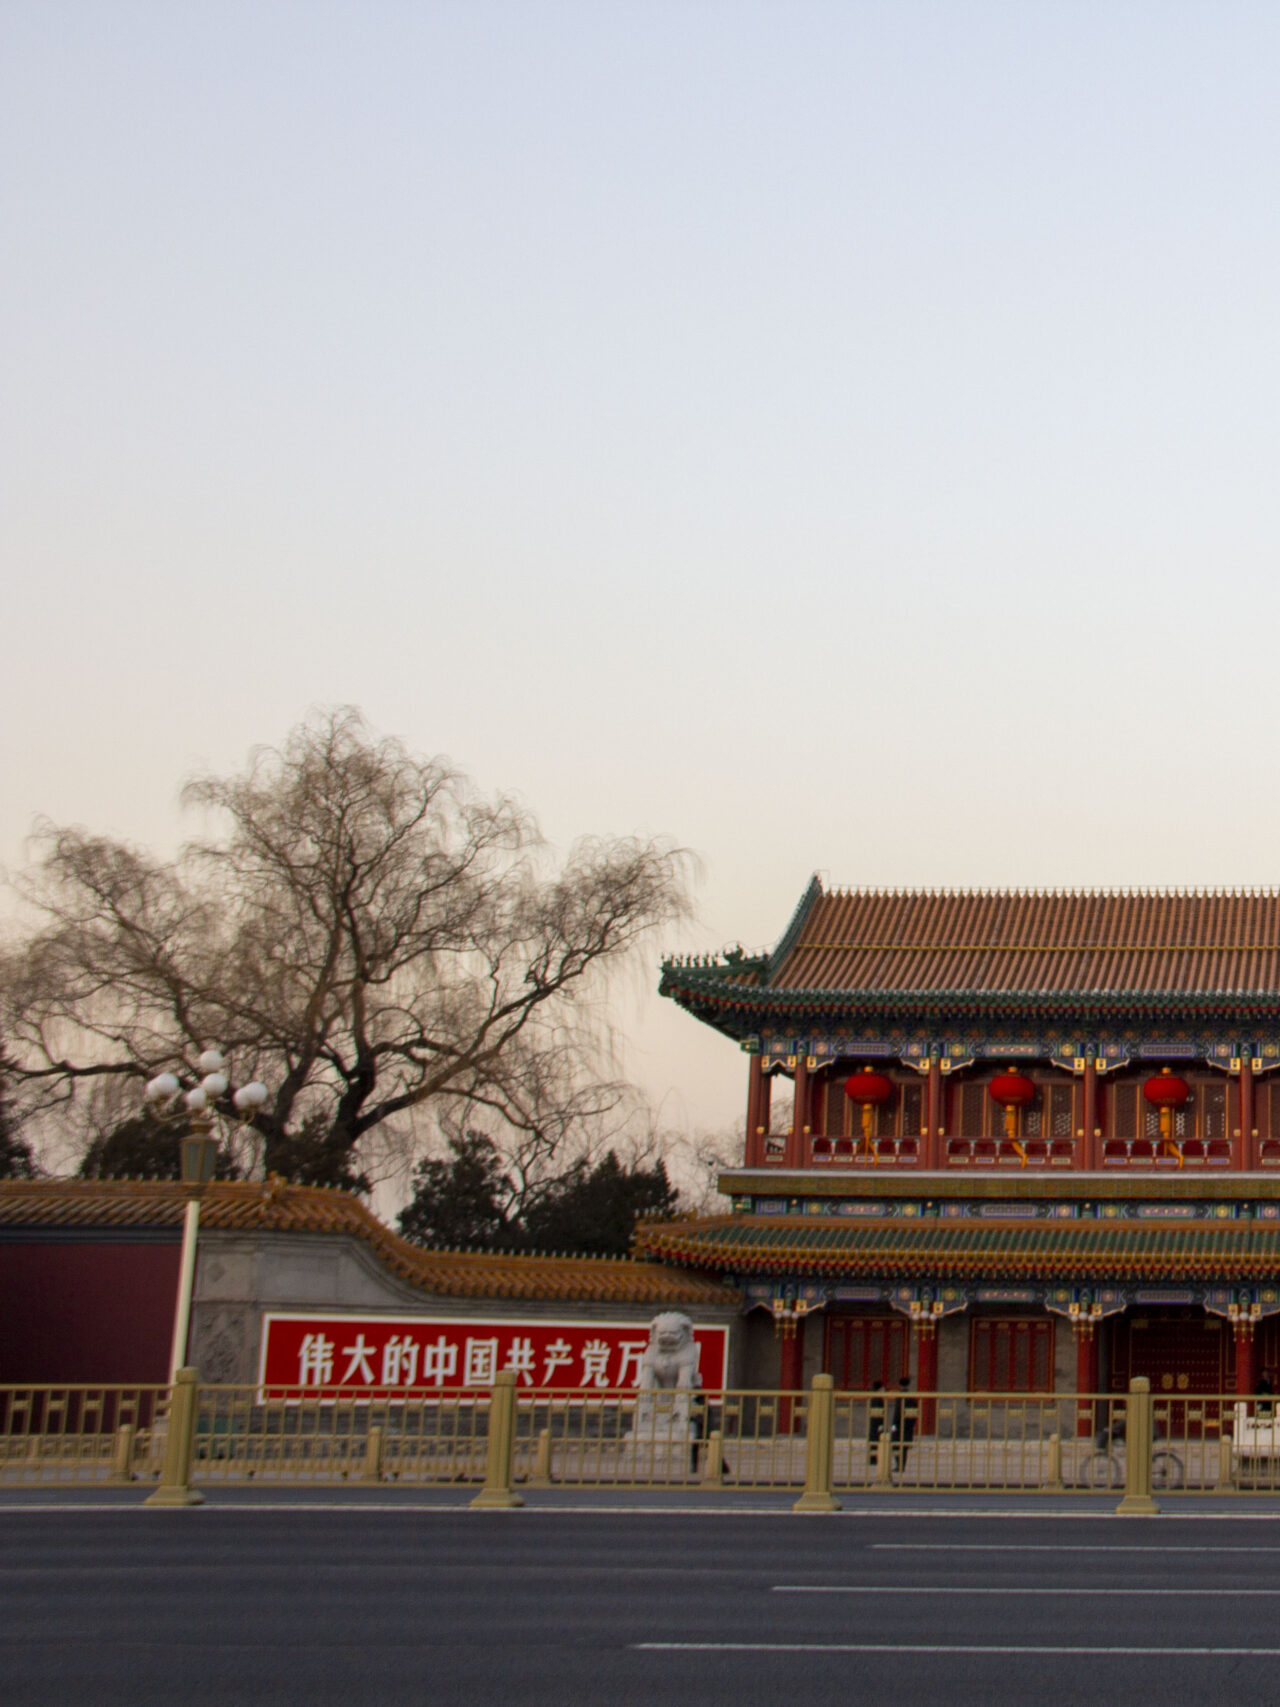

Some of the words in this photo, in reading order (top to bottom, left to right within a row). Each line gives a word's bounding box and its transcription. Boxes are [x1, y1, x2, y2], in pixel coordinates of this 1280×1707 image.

[298, 1333, 703, 1387] 伟大的中国共产党万
